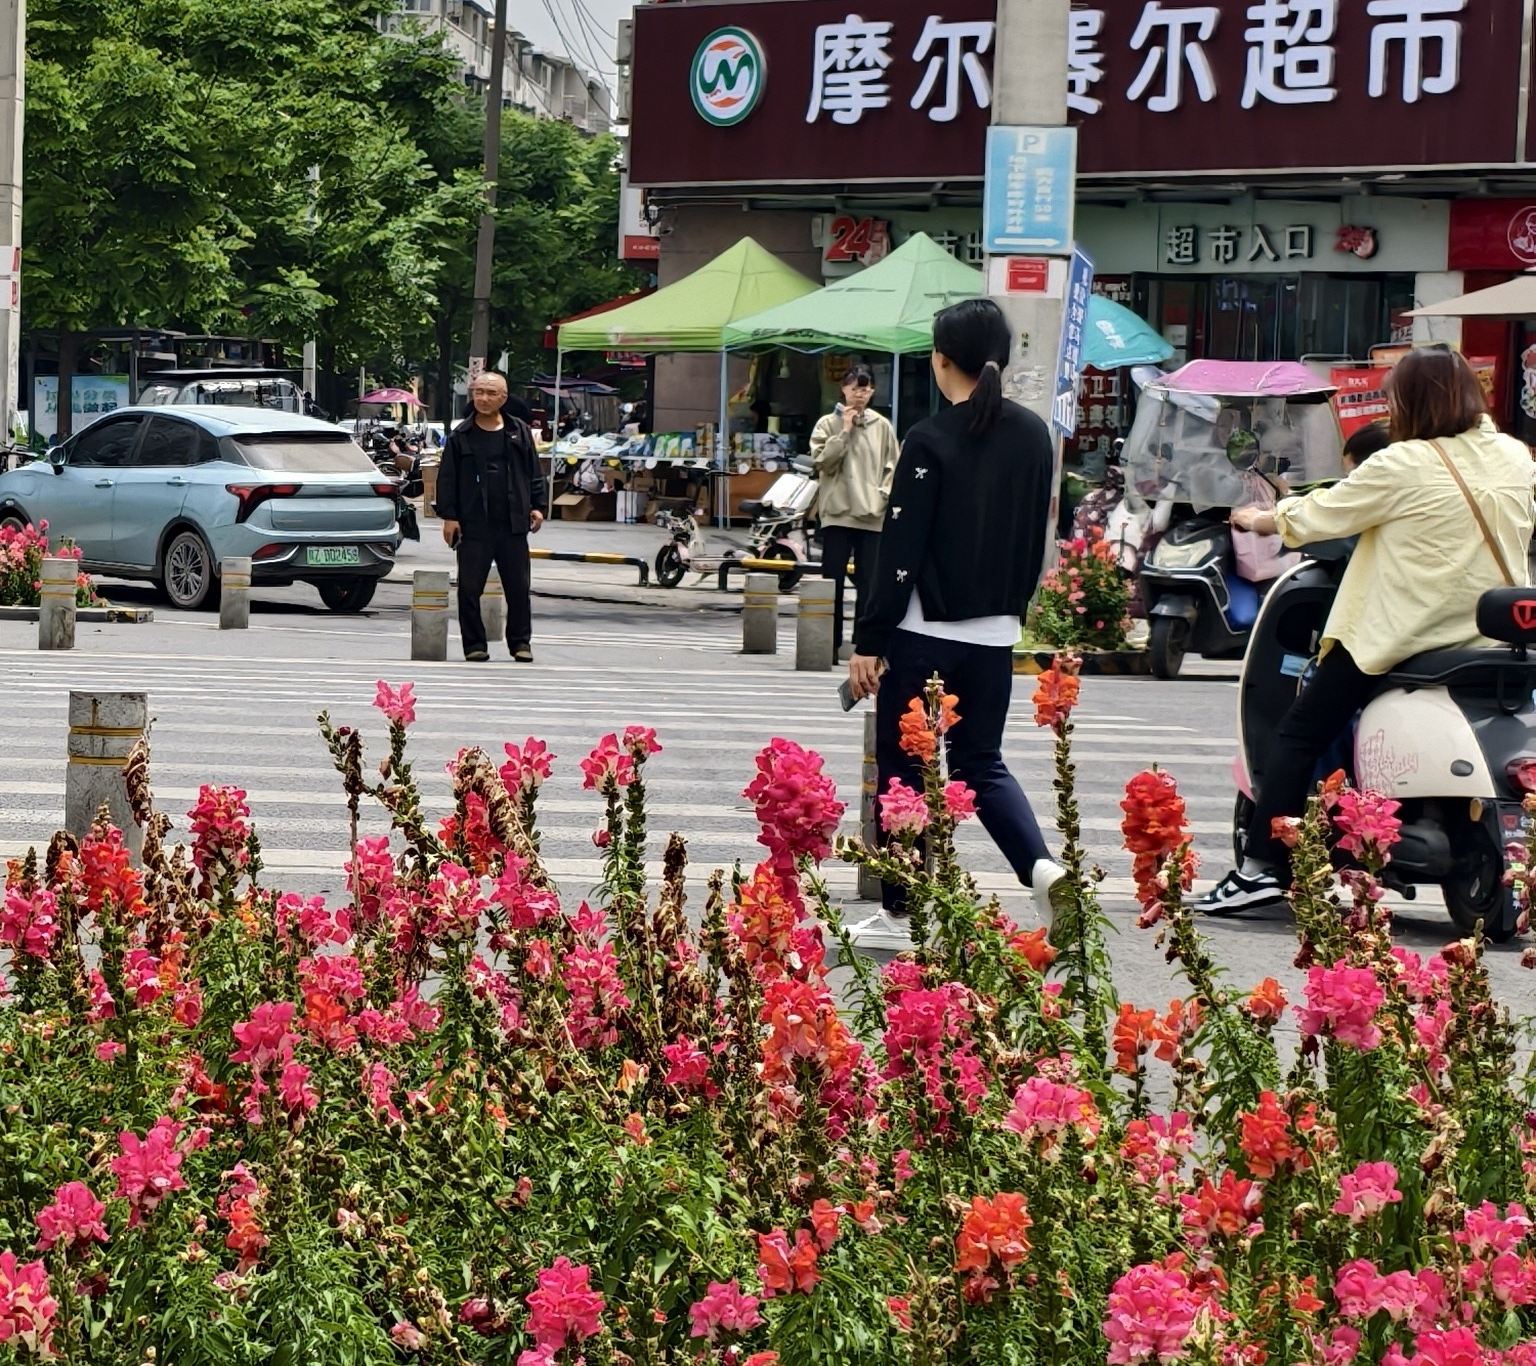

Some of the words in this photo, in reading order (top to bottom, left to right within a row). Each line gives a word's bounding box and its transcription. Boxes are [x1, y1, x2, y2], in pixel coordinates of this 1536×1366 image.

[1023, 134, 1041, 151] P
[825, 215, 873, 263] 24
[1164, 223, 1314, 264] 超市入口
